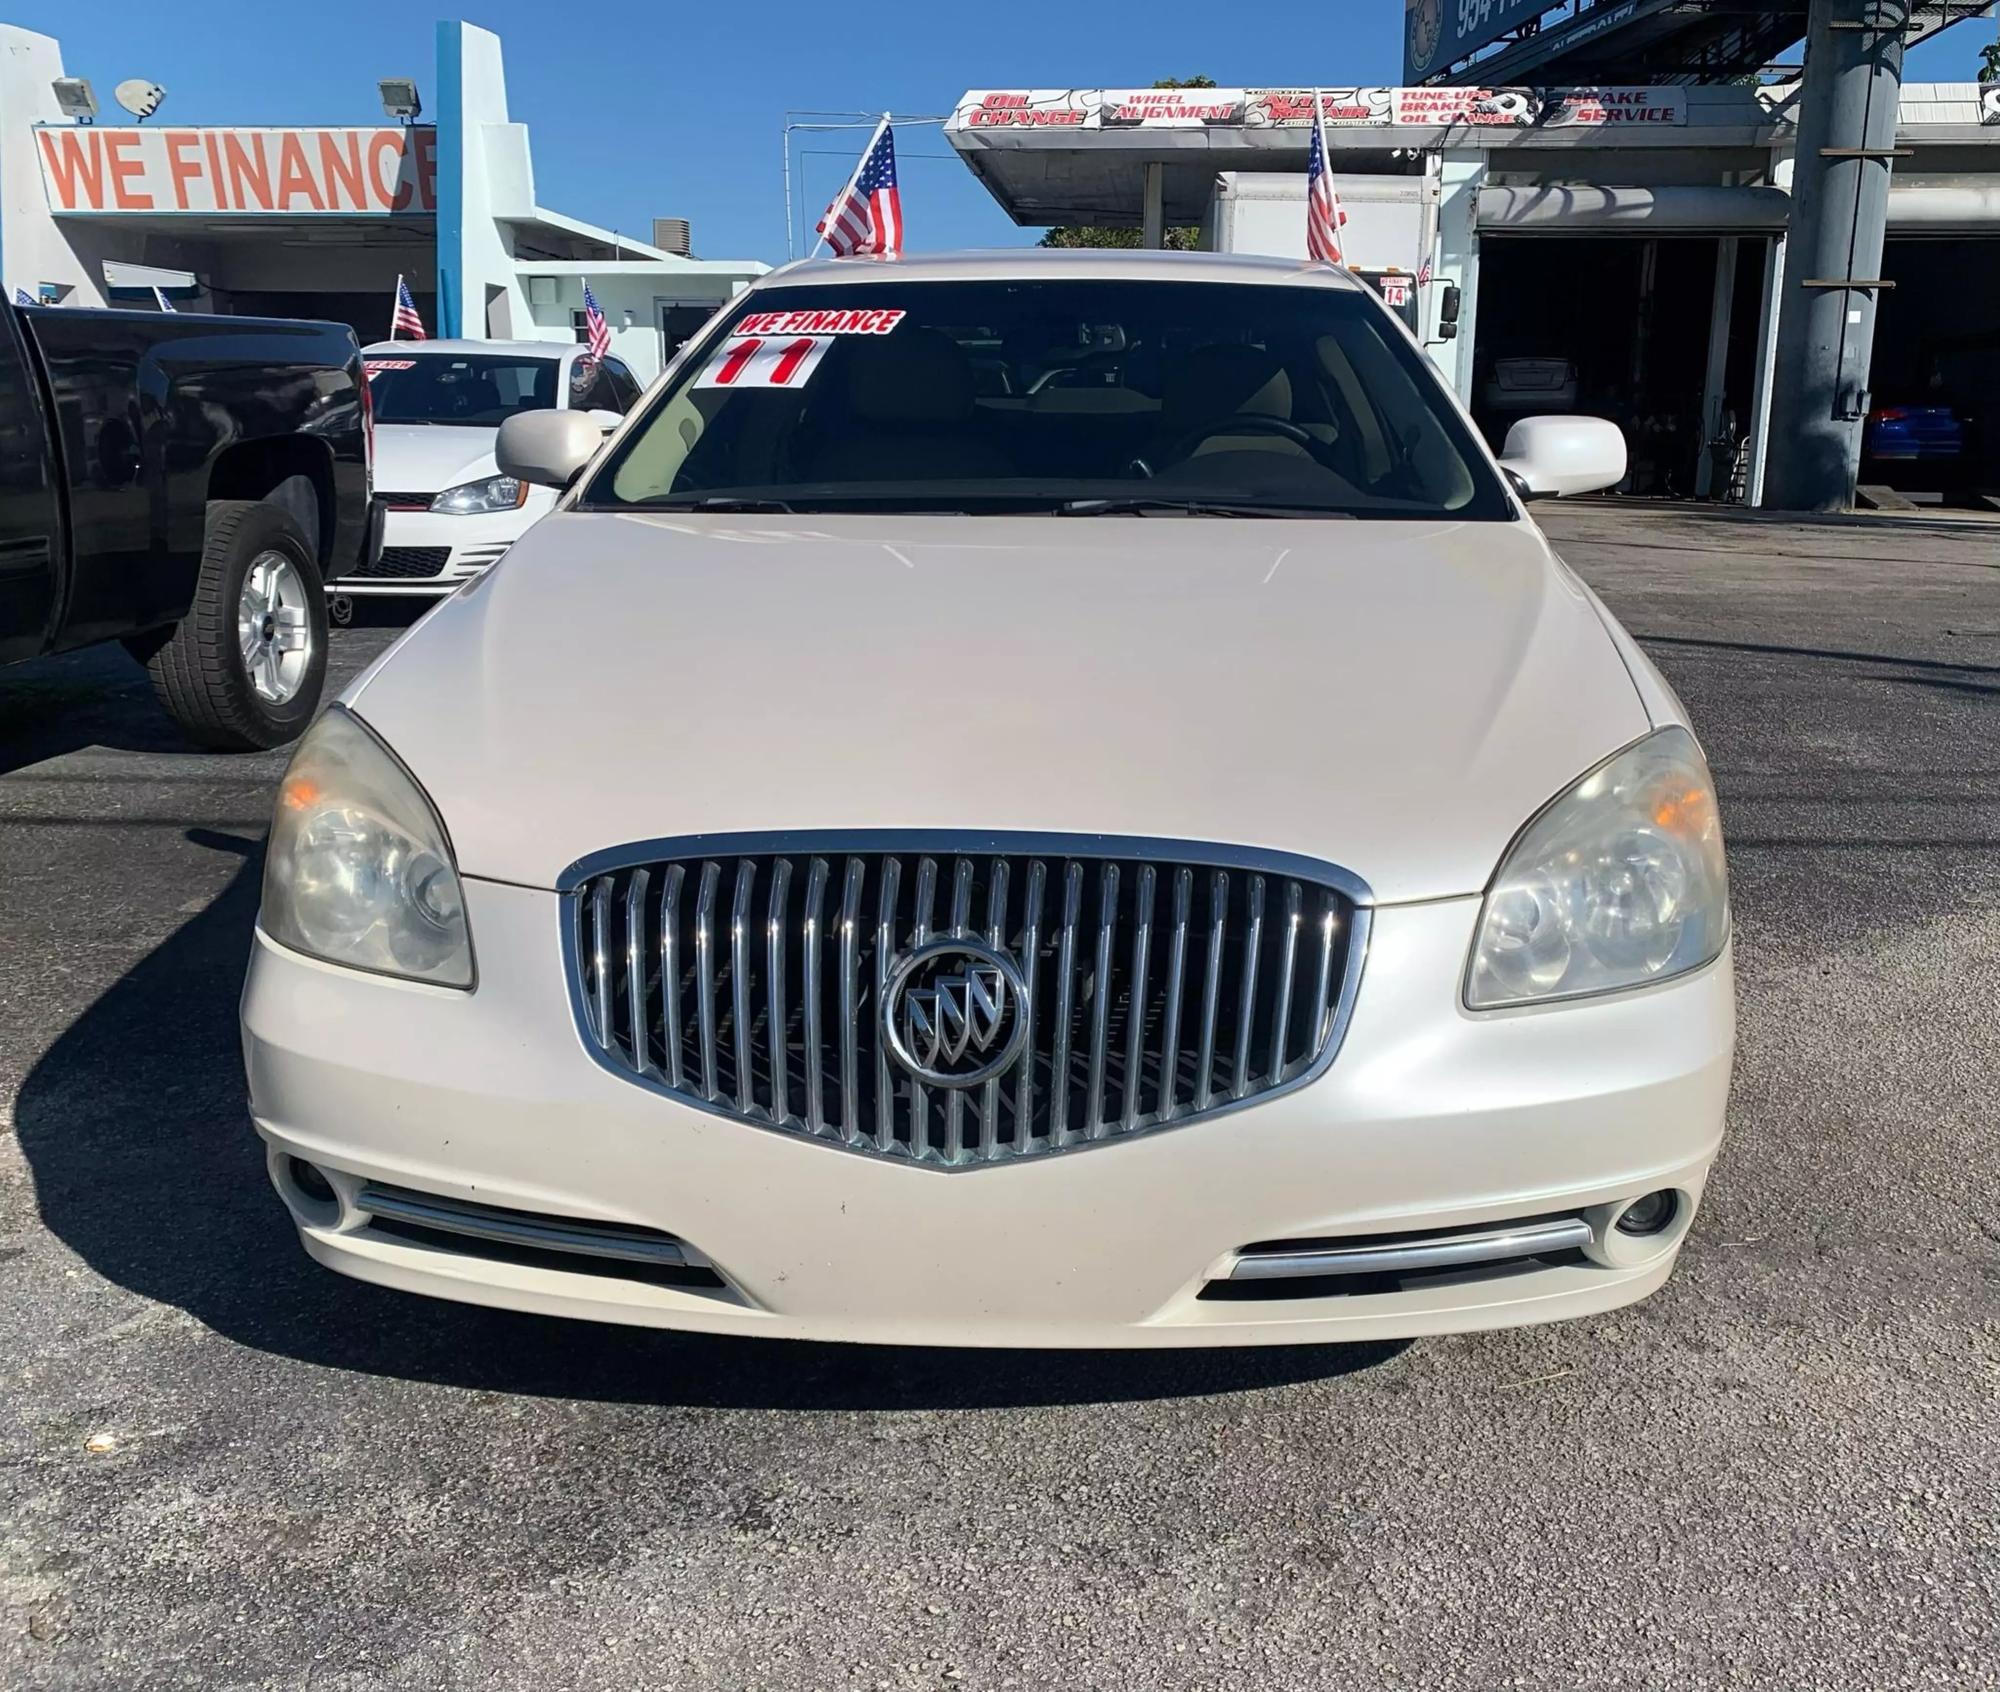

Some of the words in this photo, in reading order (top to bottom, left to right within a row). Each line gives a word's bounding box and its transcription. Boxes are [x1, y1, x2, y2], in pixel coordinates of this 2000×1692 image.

[983, 93, 1034, 109] OIL
[1129, 95, 1184, 104] WHEEL
[1258, 95, 1334, 107] AUTO
[1402, 90, 1492, 100] TUNE-UPS
[1563, 91, 1647, 105] BRAKE
[1112, 104, 1236, 120] ALIGNMENT
[1400, 101, 1477, 111] BRAKES
[969, 108, 1088, 126] CHANGE
[1400, 114, 1430, 123] OIL
[1438, 113, 1516, 123] CHANGE
[1577, 107, 1674, 121] SERVICE
[39, 131, 154, 209] WE
[164, 131, 437, 209] FINANCE
[1387, 287, 1404, 304] 14
[738, 312, 786, 333] WE
[781, 310, 903, 333] FINANCE
[715, 338, 818, 384] 11
